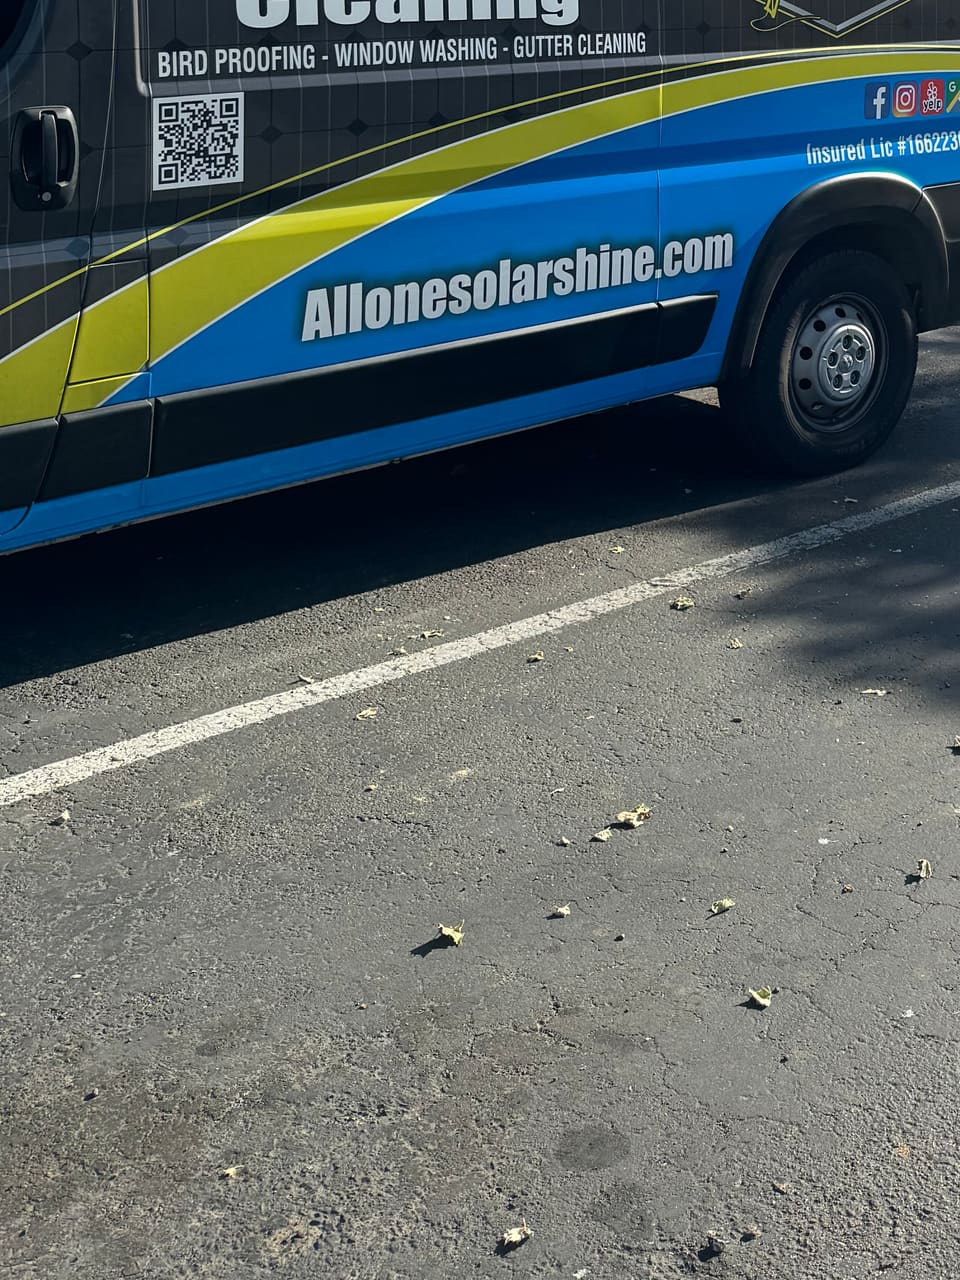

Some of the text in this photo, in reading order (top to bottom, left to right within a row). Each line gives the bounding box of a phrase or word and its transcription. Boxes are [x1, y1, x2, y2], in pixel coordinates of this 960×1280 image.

[158, 50, 207, 78] BIRD
[215, 45, 315, 74] PROOFING
[335, 40, 414, 67] WINDOW
[419, 37, 497, 63] WASHING
[514, 34, 573, 58] GUTTER
[578, 32, 646, 55] CLEANING
[922, 98, 943, 113] yelp
[806, 138, 866, 165] Insured
[871, 137, 893, 158] Lic
[301, 233, 734, 343] Allonesolarshine.com
